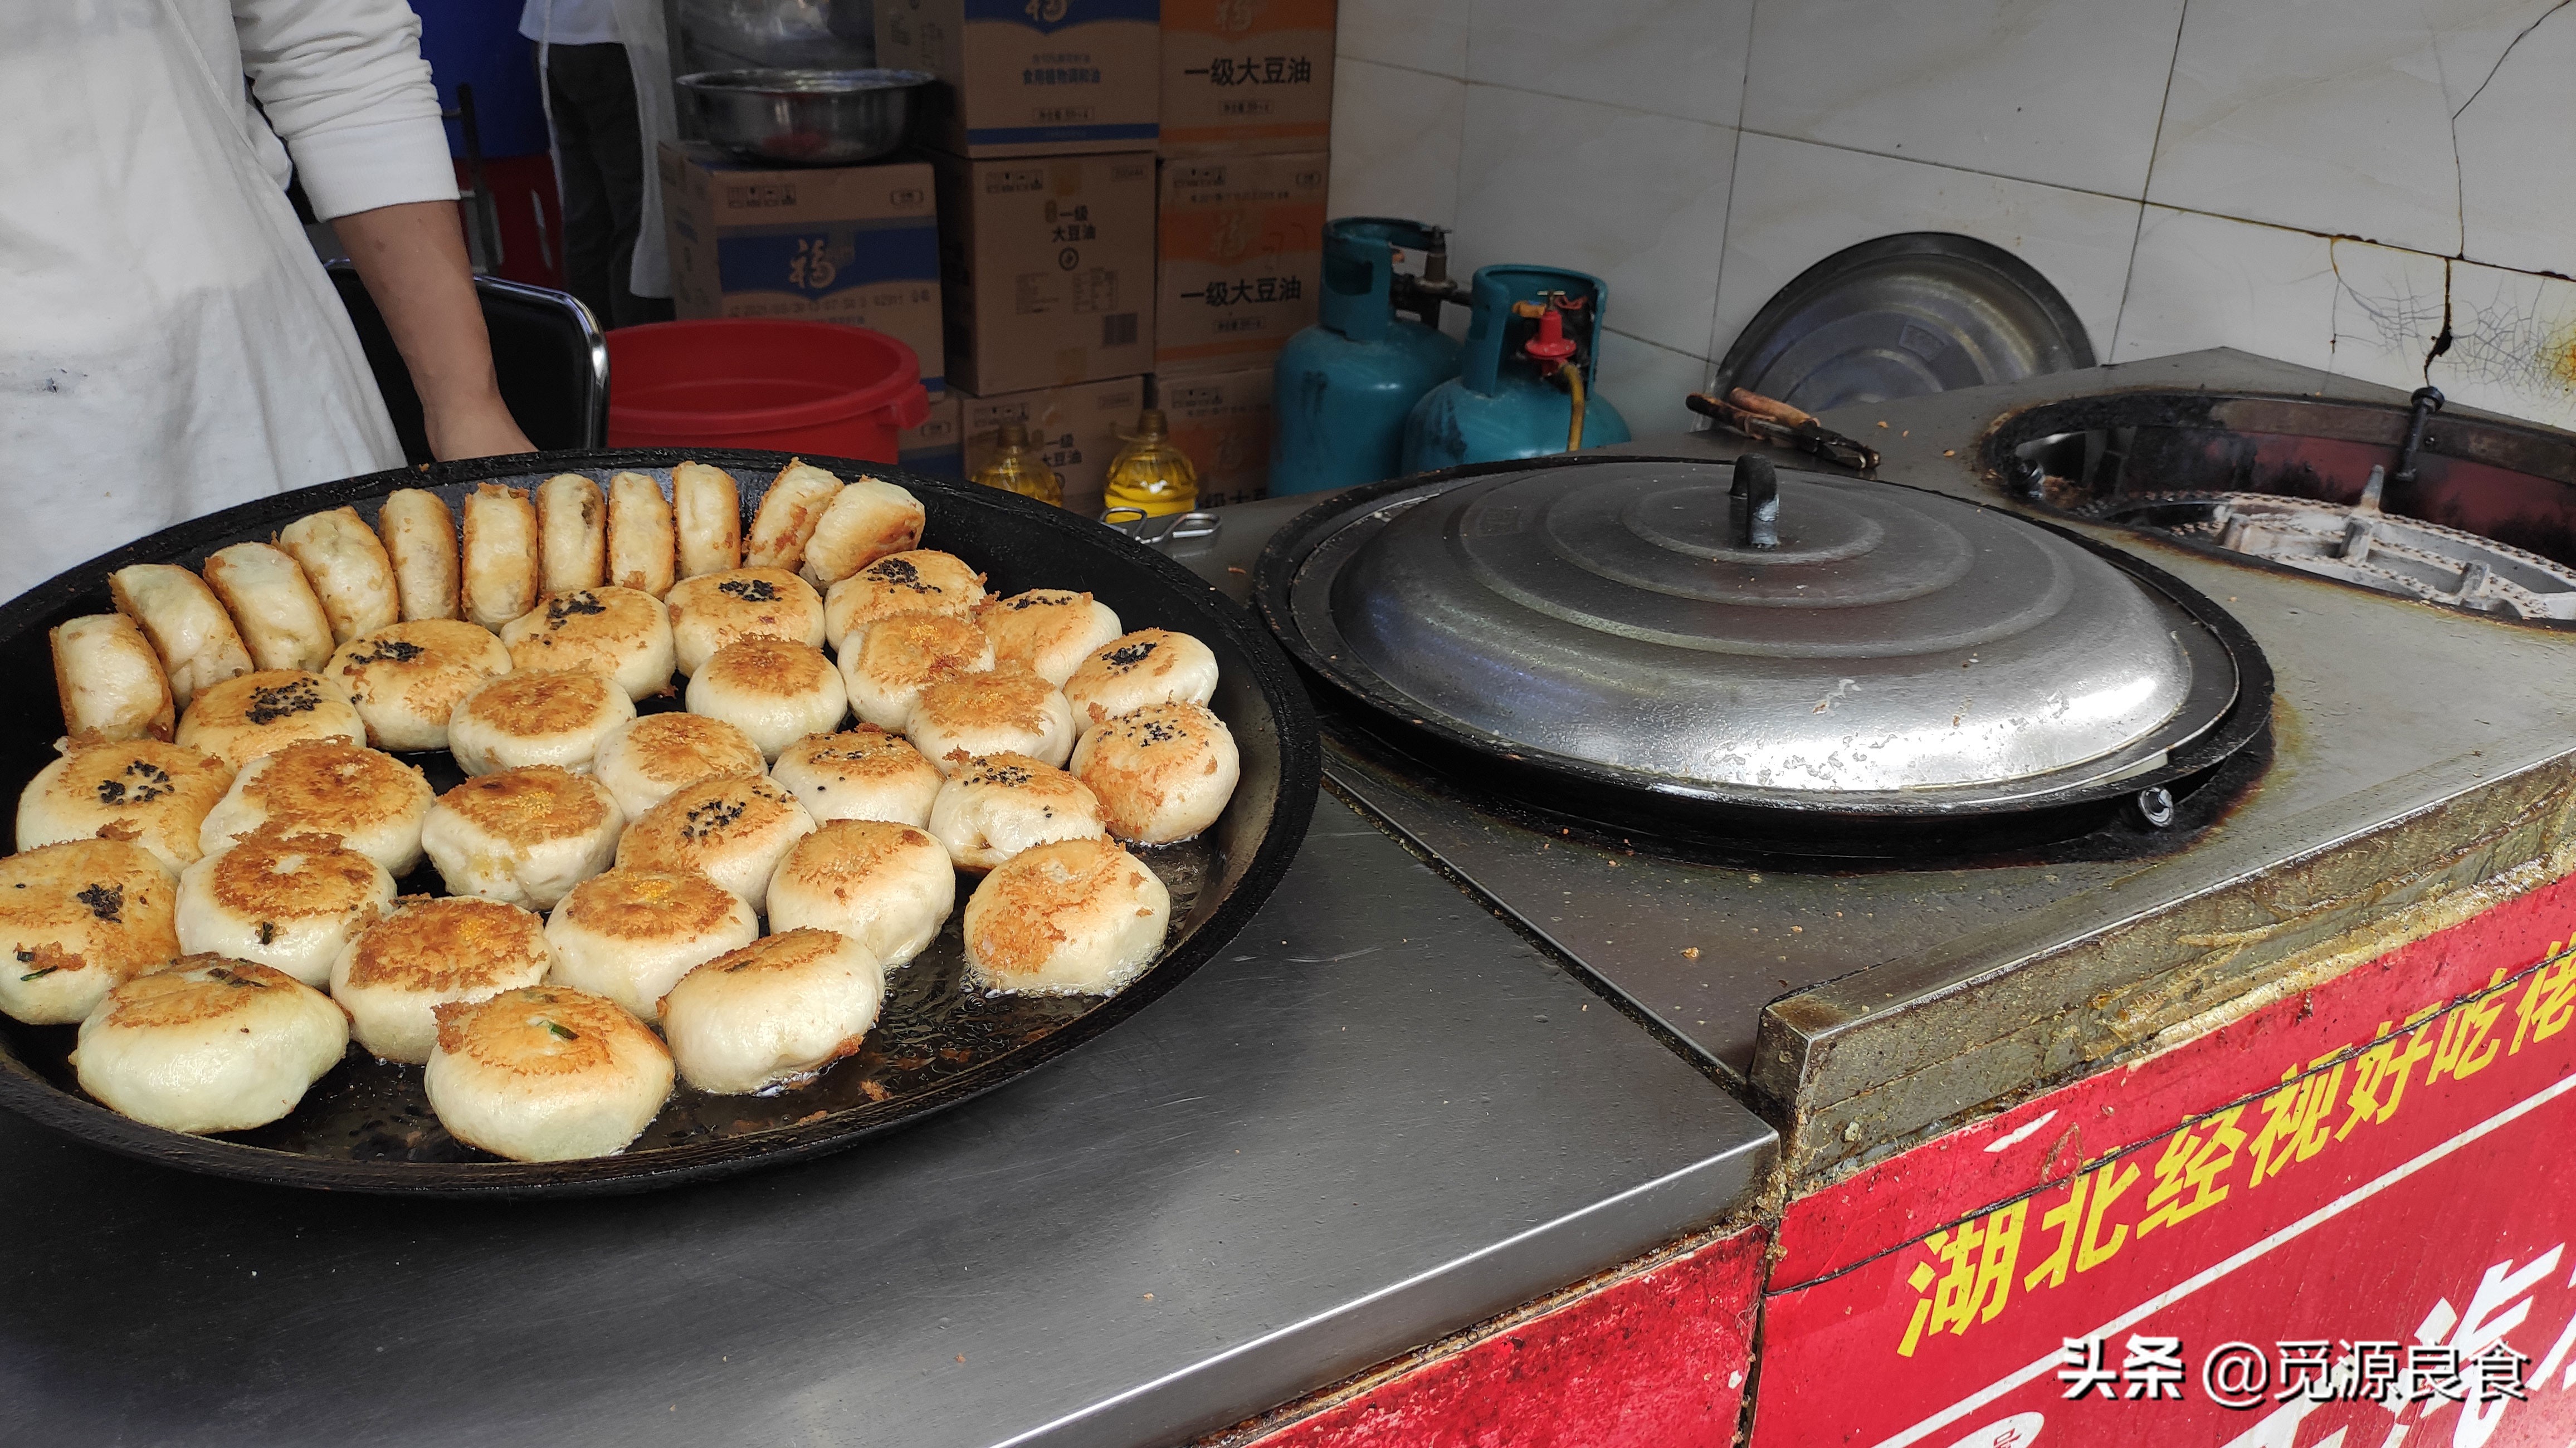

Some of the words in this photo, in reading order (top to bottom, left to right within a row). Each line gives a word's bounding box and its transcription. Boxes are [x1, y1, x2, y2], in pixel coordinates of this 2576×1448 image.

[1184, 57, 1311, 85] 一级大豆油
[1060, 204, 1089, 221] 一级
[1052, 224, 1096, 243] 大豆油
[1180, 275, 1301, 307] 一级大豆油
